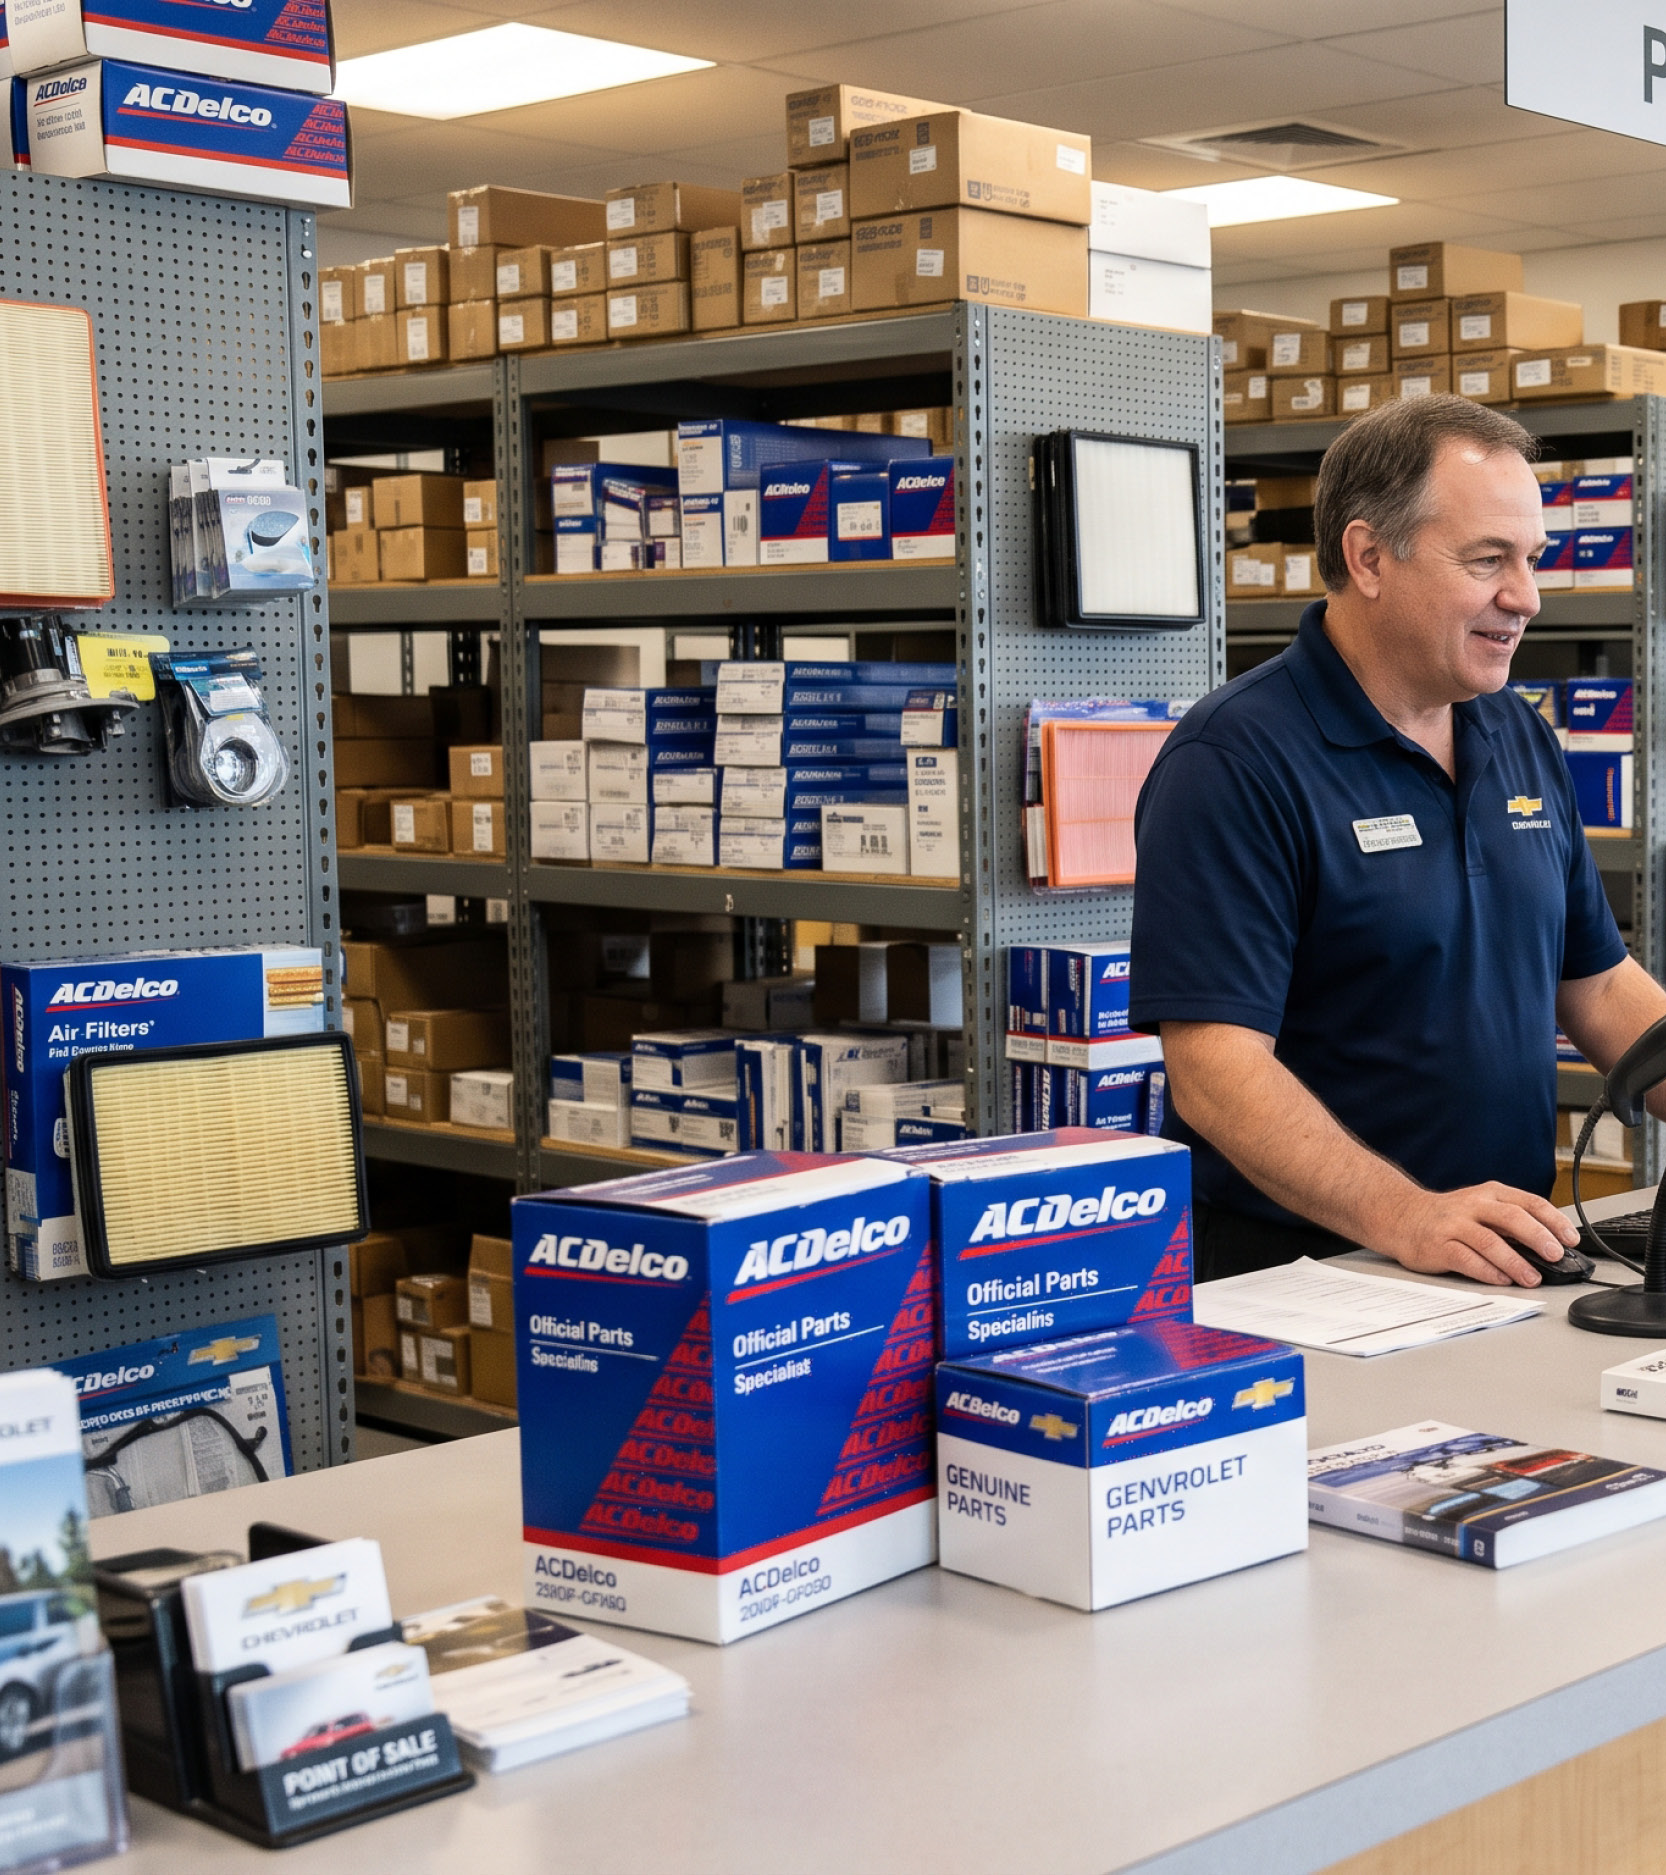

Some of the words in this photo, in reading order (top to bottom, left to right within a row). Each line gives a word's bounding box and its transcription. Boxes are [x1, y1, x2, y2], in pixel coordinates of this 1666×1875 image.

[123, 83, 272, 128] ACDelco
[51, 977, 179, 1004] ACDelco
[969, 1186, 1166, 1243] ACDelco
[529, 1234, 689, 1281] ACDelco
[734, 1215, 910, 1286] ACDelco
[967, 1273, 1040, 1305] Official
[1046, 1268, 1098, 1293] Parts
[530, 1315, 585, 1340] Official
[588, 1322, 634, 1347] Parts
[733, 1318, 797, 1358] Official
[801, 1312, 851, 1341] Parts
[1107, 1397, 1213, 1437] ACDelco
[946, 1463, 1031, 1507] GENUINE
[1106, 1453, 1248, 1509] GENVROLET
[947, 1490, 1006, 1526] PARTS
[1107, 1499, 1186, 1538] PARTS
[535, 1554, 617, 1588] ACDelco
[738, 1557, 820, 1599] ACDelco
[240, 1606, 360, 1651] CHEVROLET
[351, 1745, 381, 1775] OF
[382, 1728, 438, 1767] SALE
